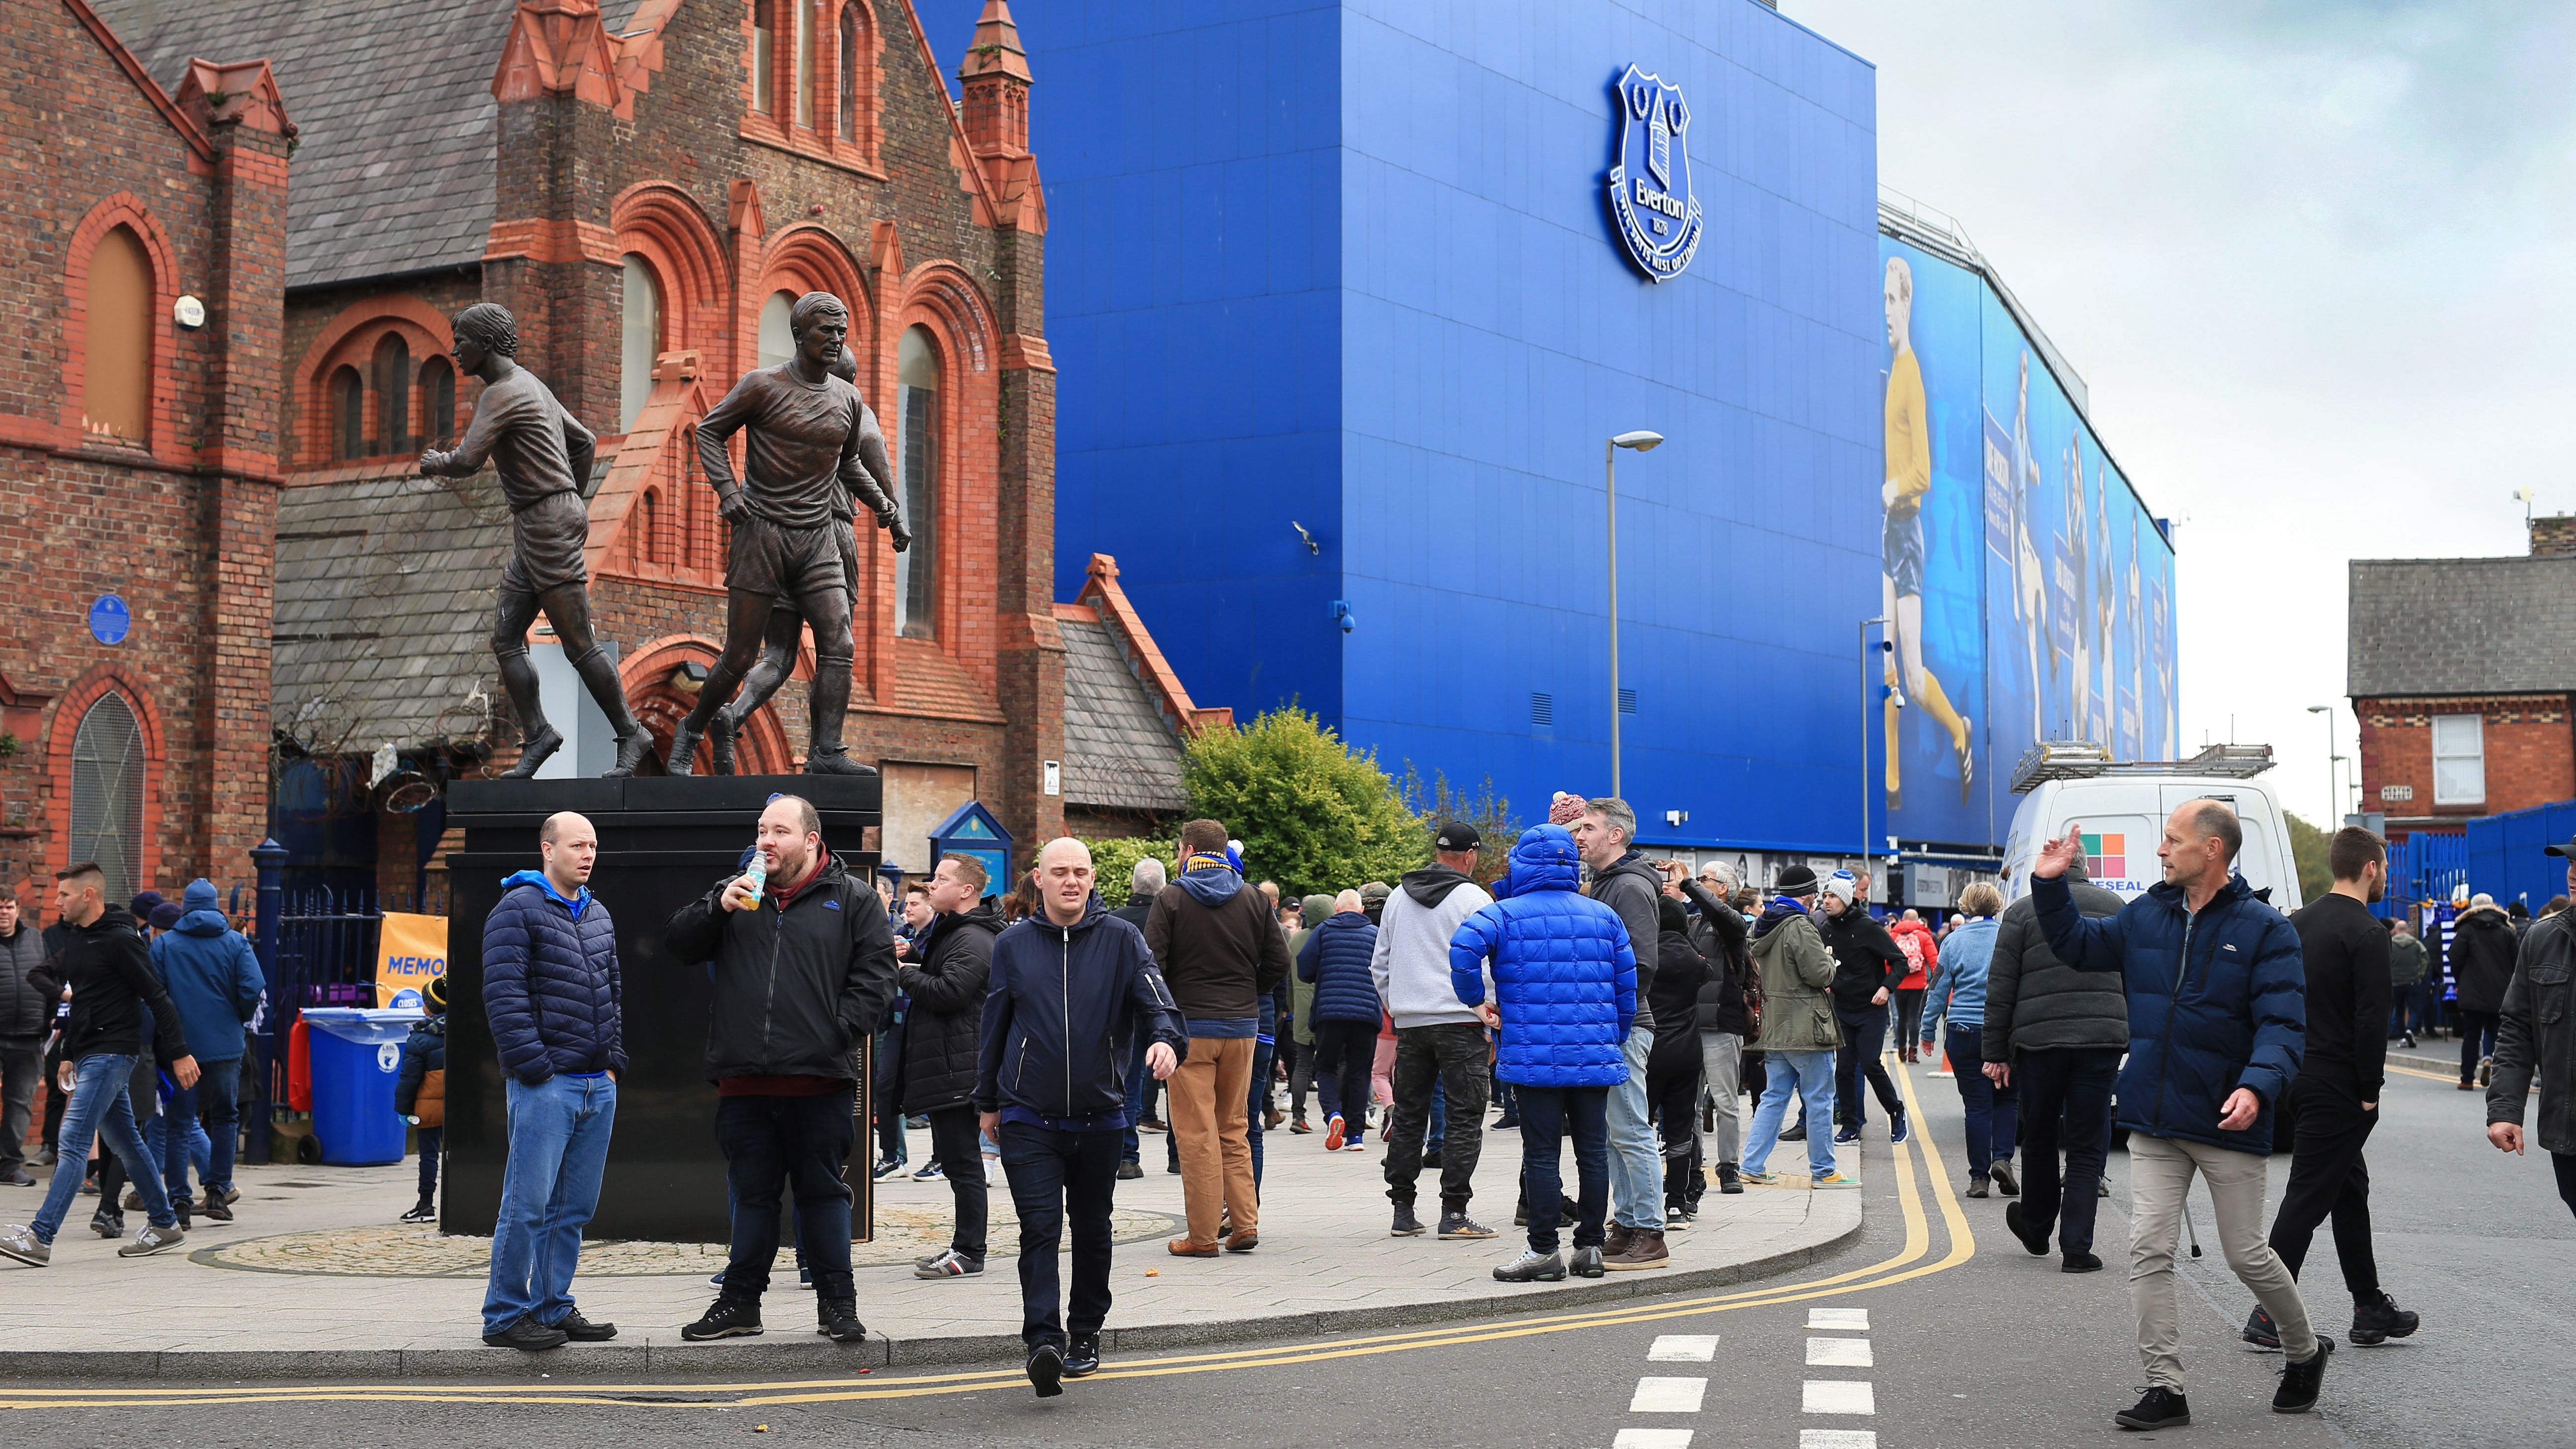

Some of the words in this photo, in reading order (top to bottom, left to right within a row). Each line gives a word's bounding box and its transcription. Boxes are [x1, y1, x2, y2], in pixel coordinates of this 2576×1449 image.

[1636, 177, 1685, 220] Everton
[1652, 217, 1669, 236] 1878
[1630, 227, 1651, 262] SATIS
[1652, 255, 1671, 272] NISI
[1671, 224, 1701, 270] OPTIMUM
[2089, 881, 2146, 890] ESEAL
[387, 956, 445, 976] MEMO
[398, 998, 417, 1008] CLOSES
